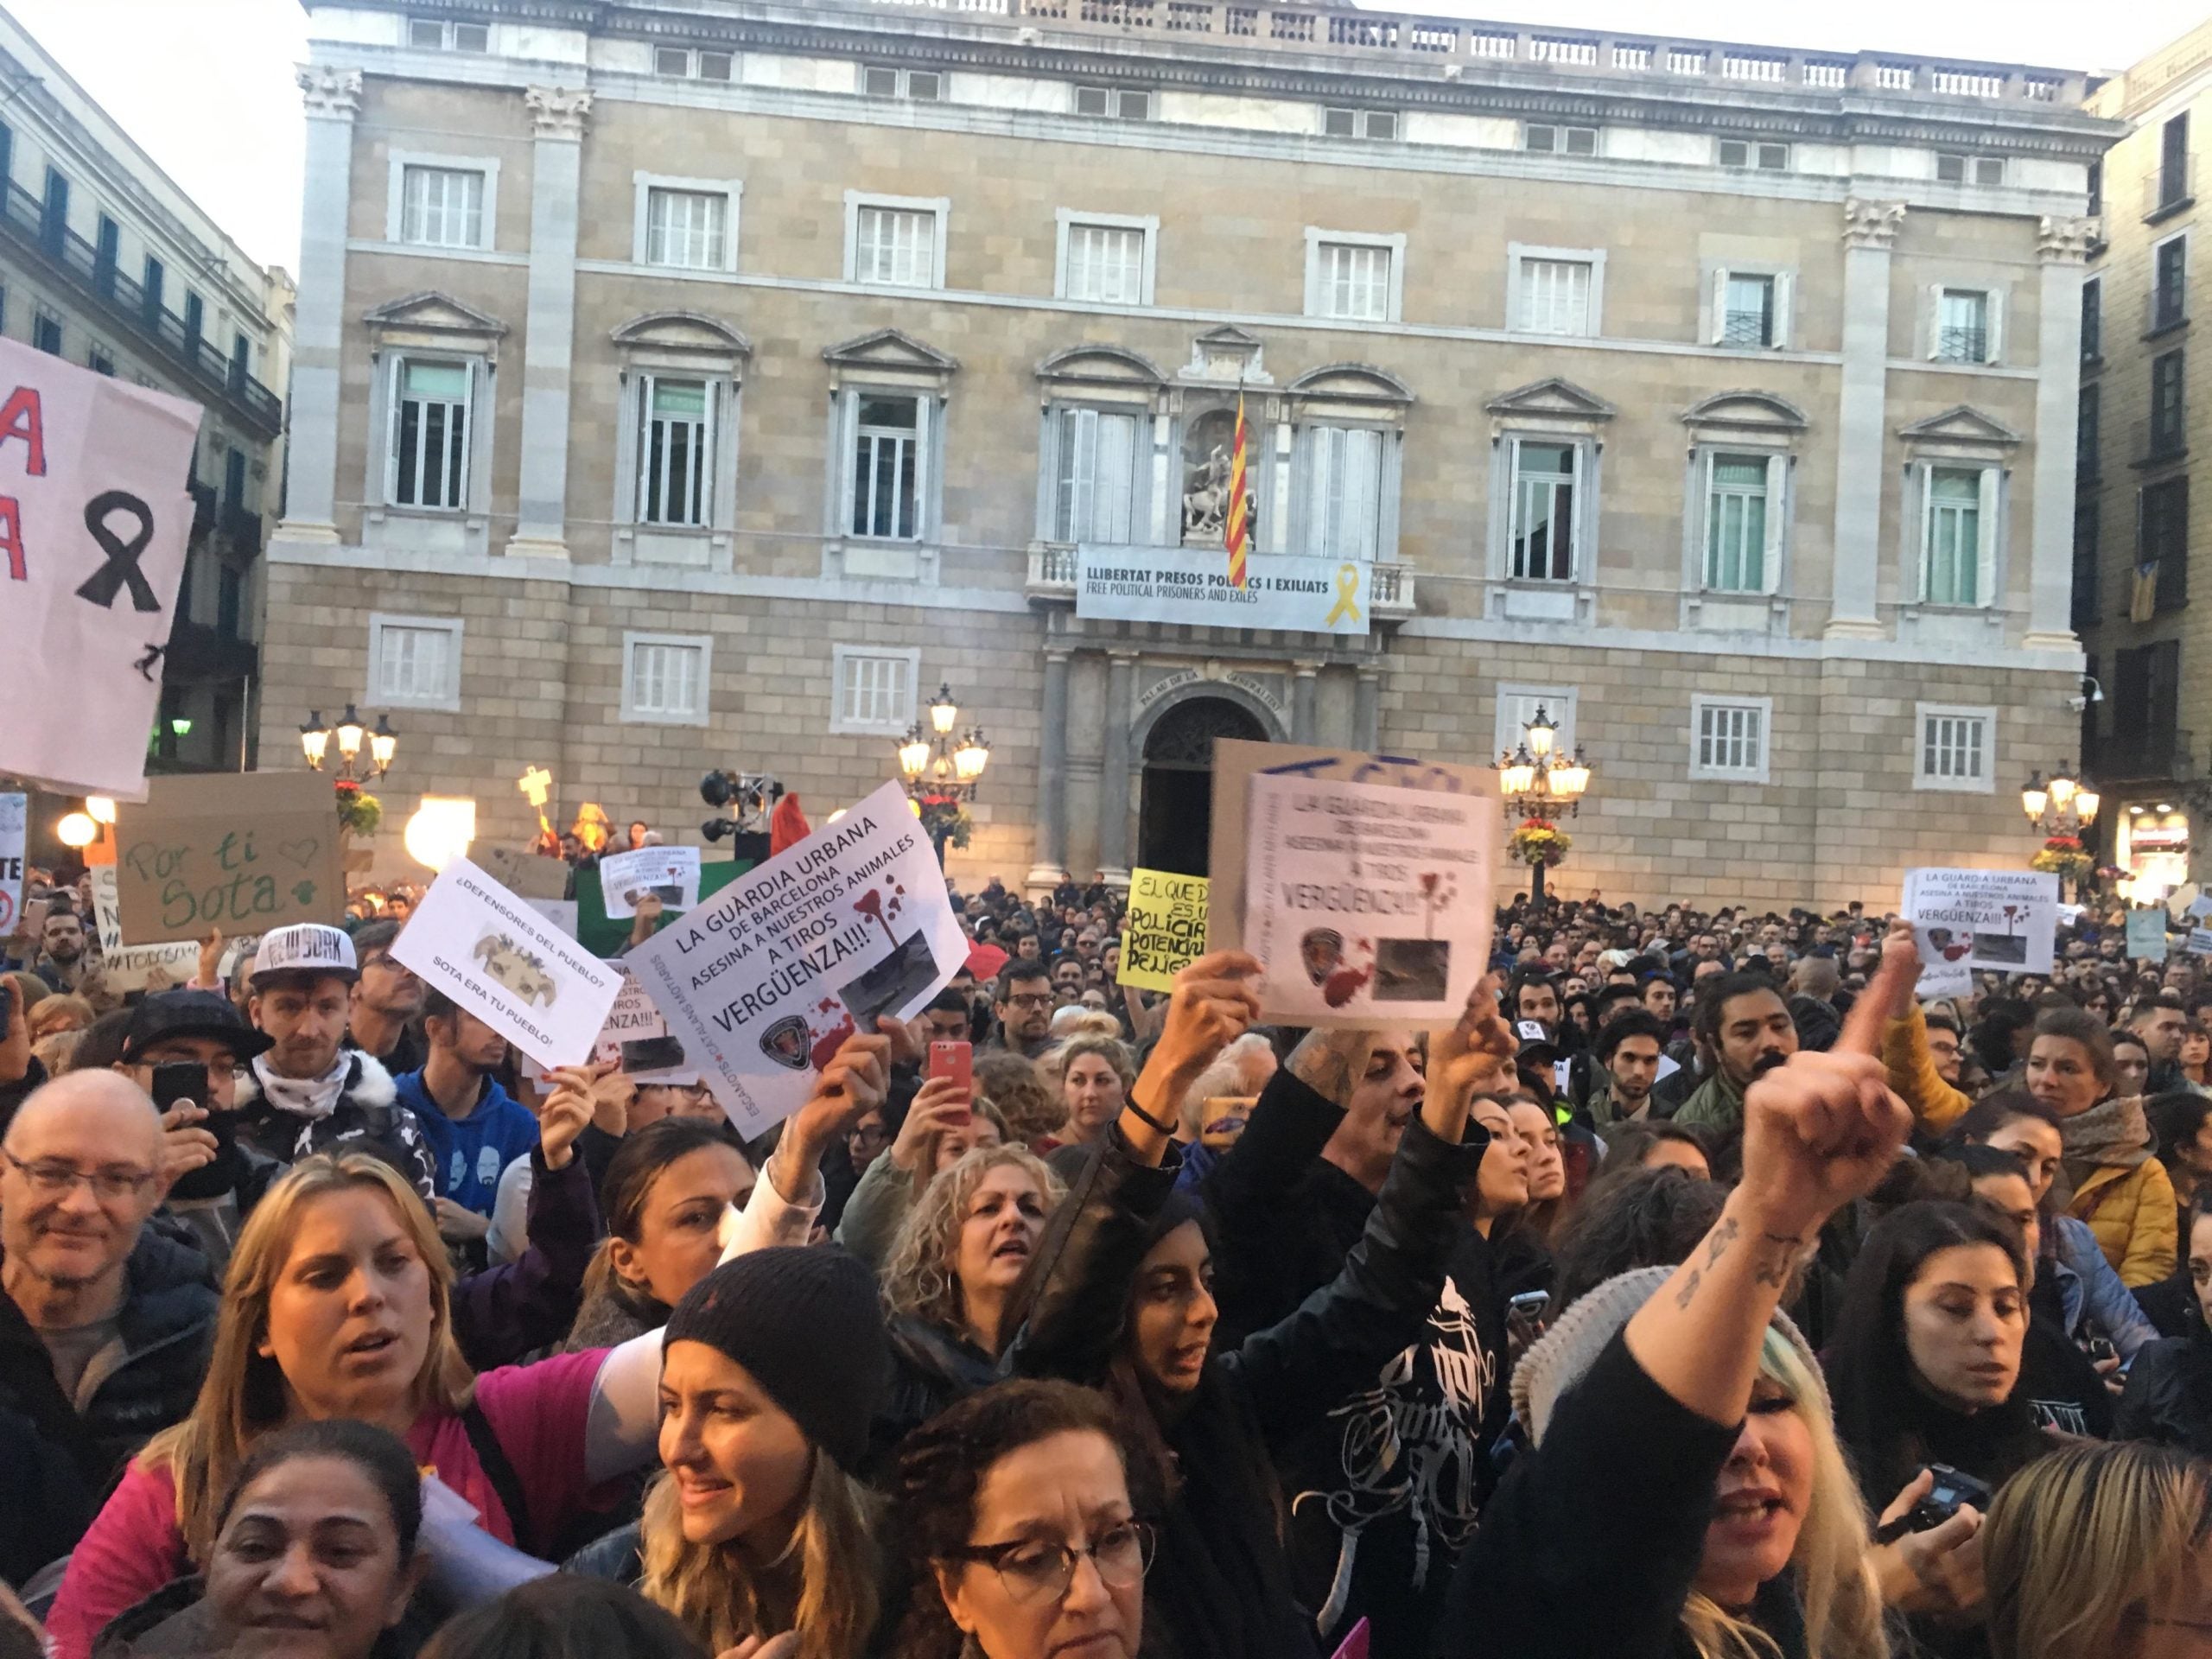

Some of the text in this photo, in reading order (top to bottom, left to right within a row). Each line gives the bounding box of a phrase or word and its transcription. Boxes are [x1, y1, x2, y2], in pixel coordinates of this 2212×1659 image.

[1086, 582, 1258, 604] FREE POLITICAL PRISONERS AND EXILES
[1087, 567, 1328, 594] LLIBERTAT PRESOS POLICS I EXILIATS
[126, 830, 258, 882] Por ti
[1925, 873, 1938, 882] LA
[1992, 874, 2037, 886] URBANA
[161, 873, 288, 930] Sota
[675, 816, 878, 955] LA GUÀRDIA URBANA
[690, 833, 915, 991] ASESINA A NUESTROS ANIMALES
[728, 865, 841, 941] DE BARCELONA
[1138, 876, 1163, 899] EL
[1165, 880, 1194, 902] QUE
[1171, 902, 1194, 918] ES
[1919, 888, 1953, 897] ASESINA
[455, 876, 606, 989] ¿DEFENSORES DEL PUEBLO?
[768, 911, 839, 965] A TIROS
[1917, 907, 2002, 925] VERGÜENZA!!!
[432, 955, 555, 1048] SOTA ERA TU PUEBLO!
[712, 922, 872, 1033] VERGÜENZA!!!
